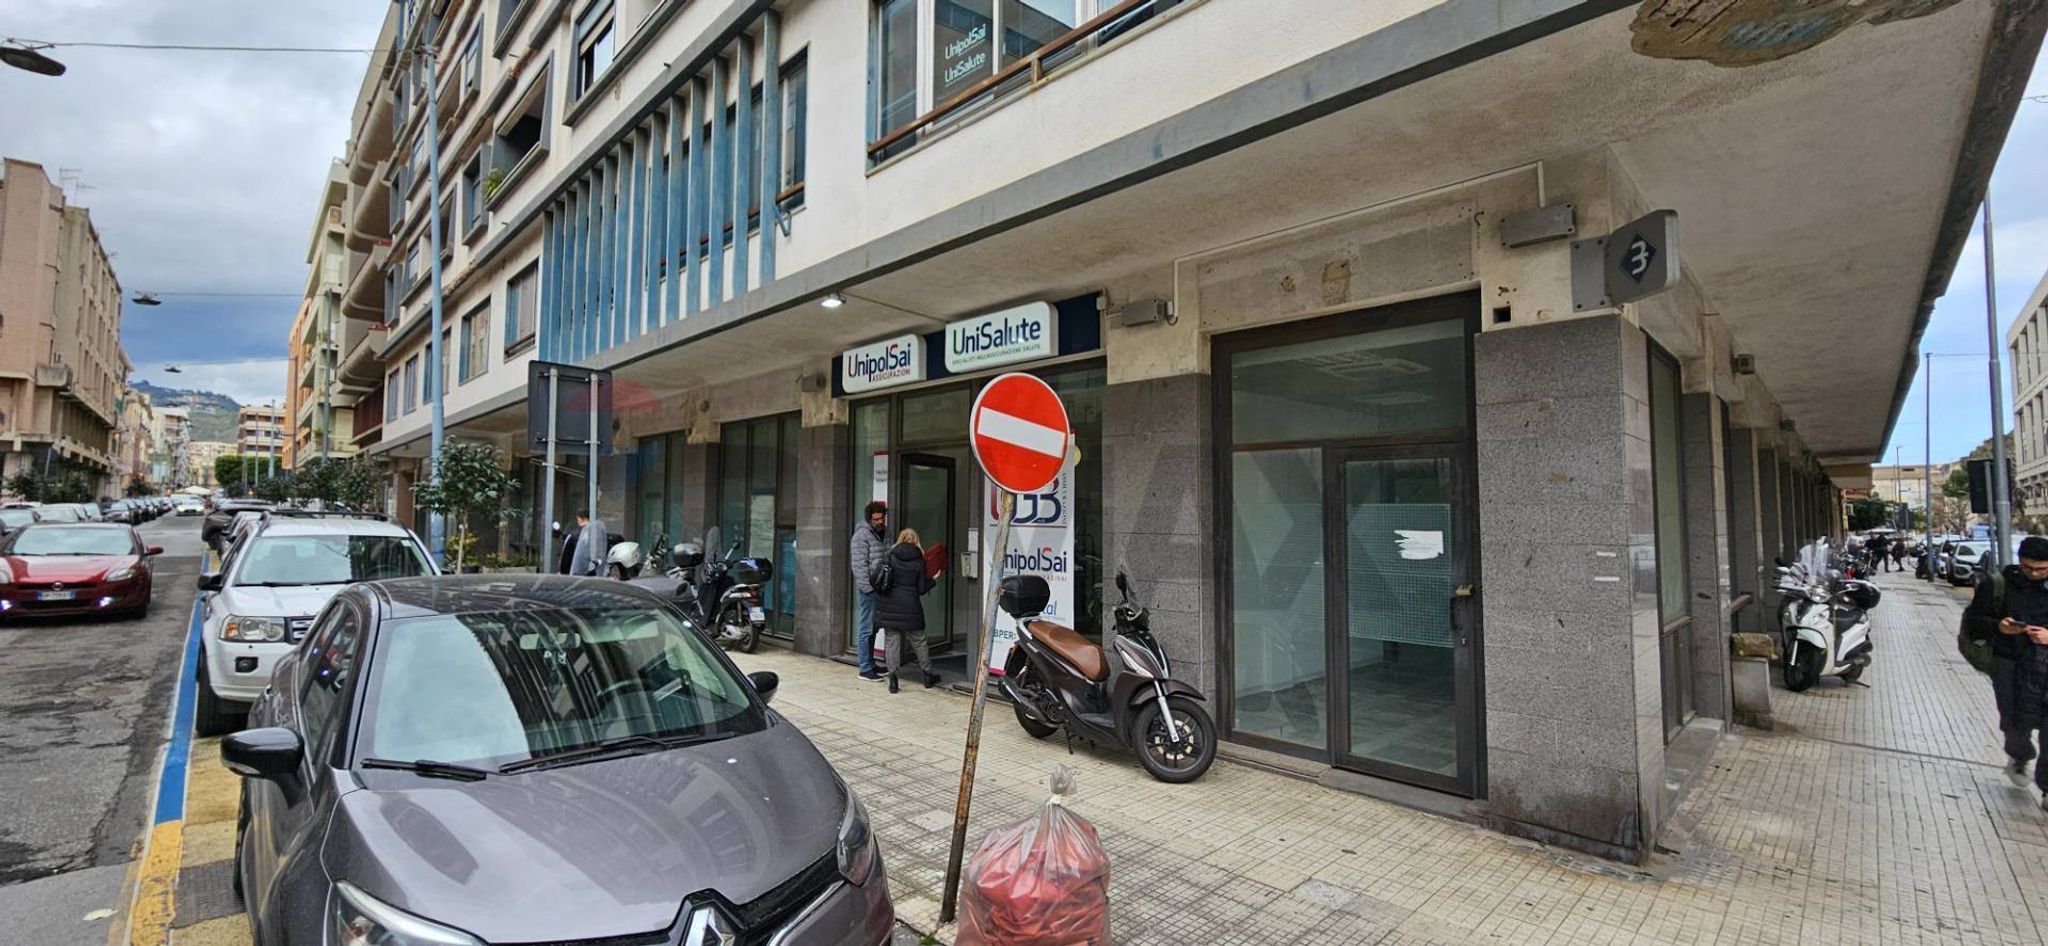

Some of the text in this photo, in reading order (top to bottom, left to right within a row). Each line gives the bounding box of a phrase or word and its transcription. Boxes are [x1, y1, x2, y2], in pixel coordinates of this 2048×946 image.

[945, 24, 986, 59] UnipolSai
[944, 53, 986, 82] UniSalute
[952, 317, 1041, 355] UniSalute
[848, 343, 911, 382] UnipolSai
[872, 368, 911, 382] ASSICURAZIONI
[1003, 546, 1067, 576] nipolSai
